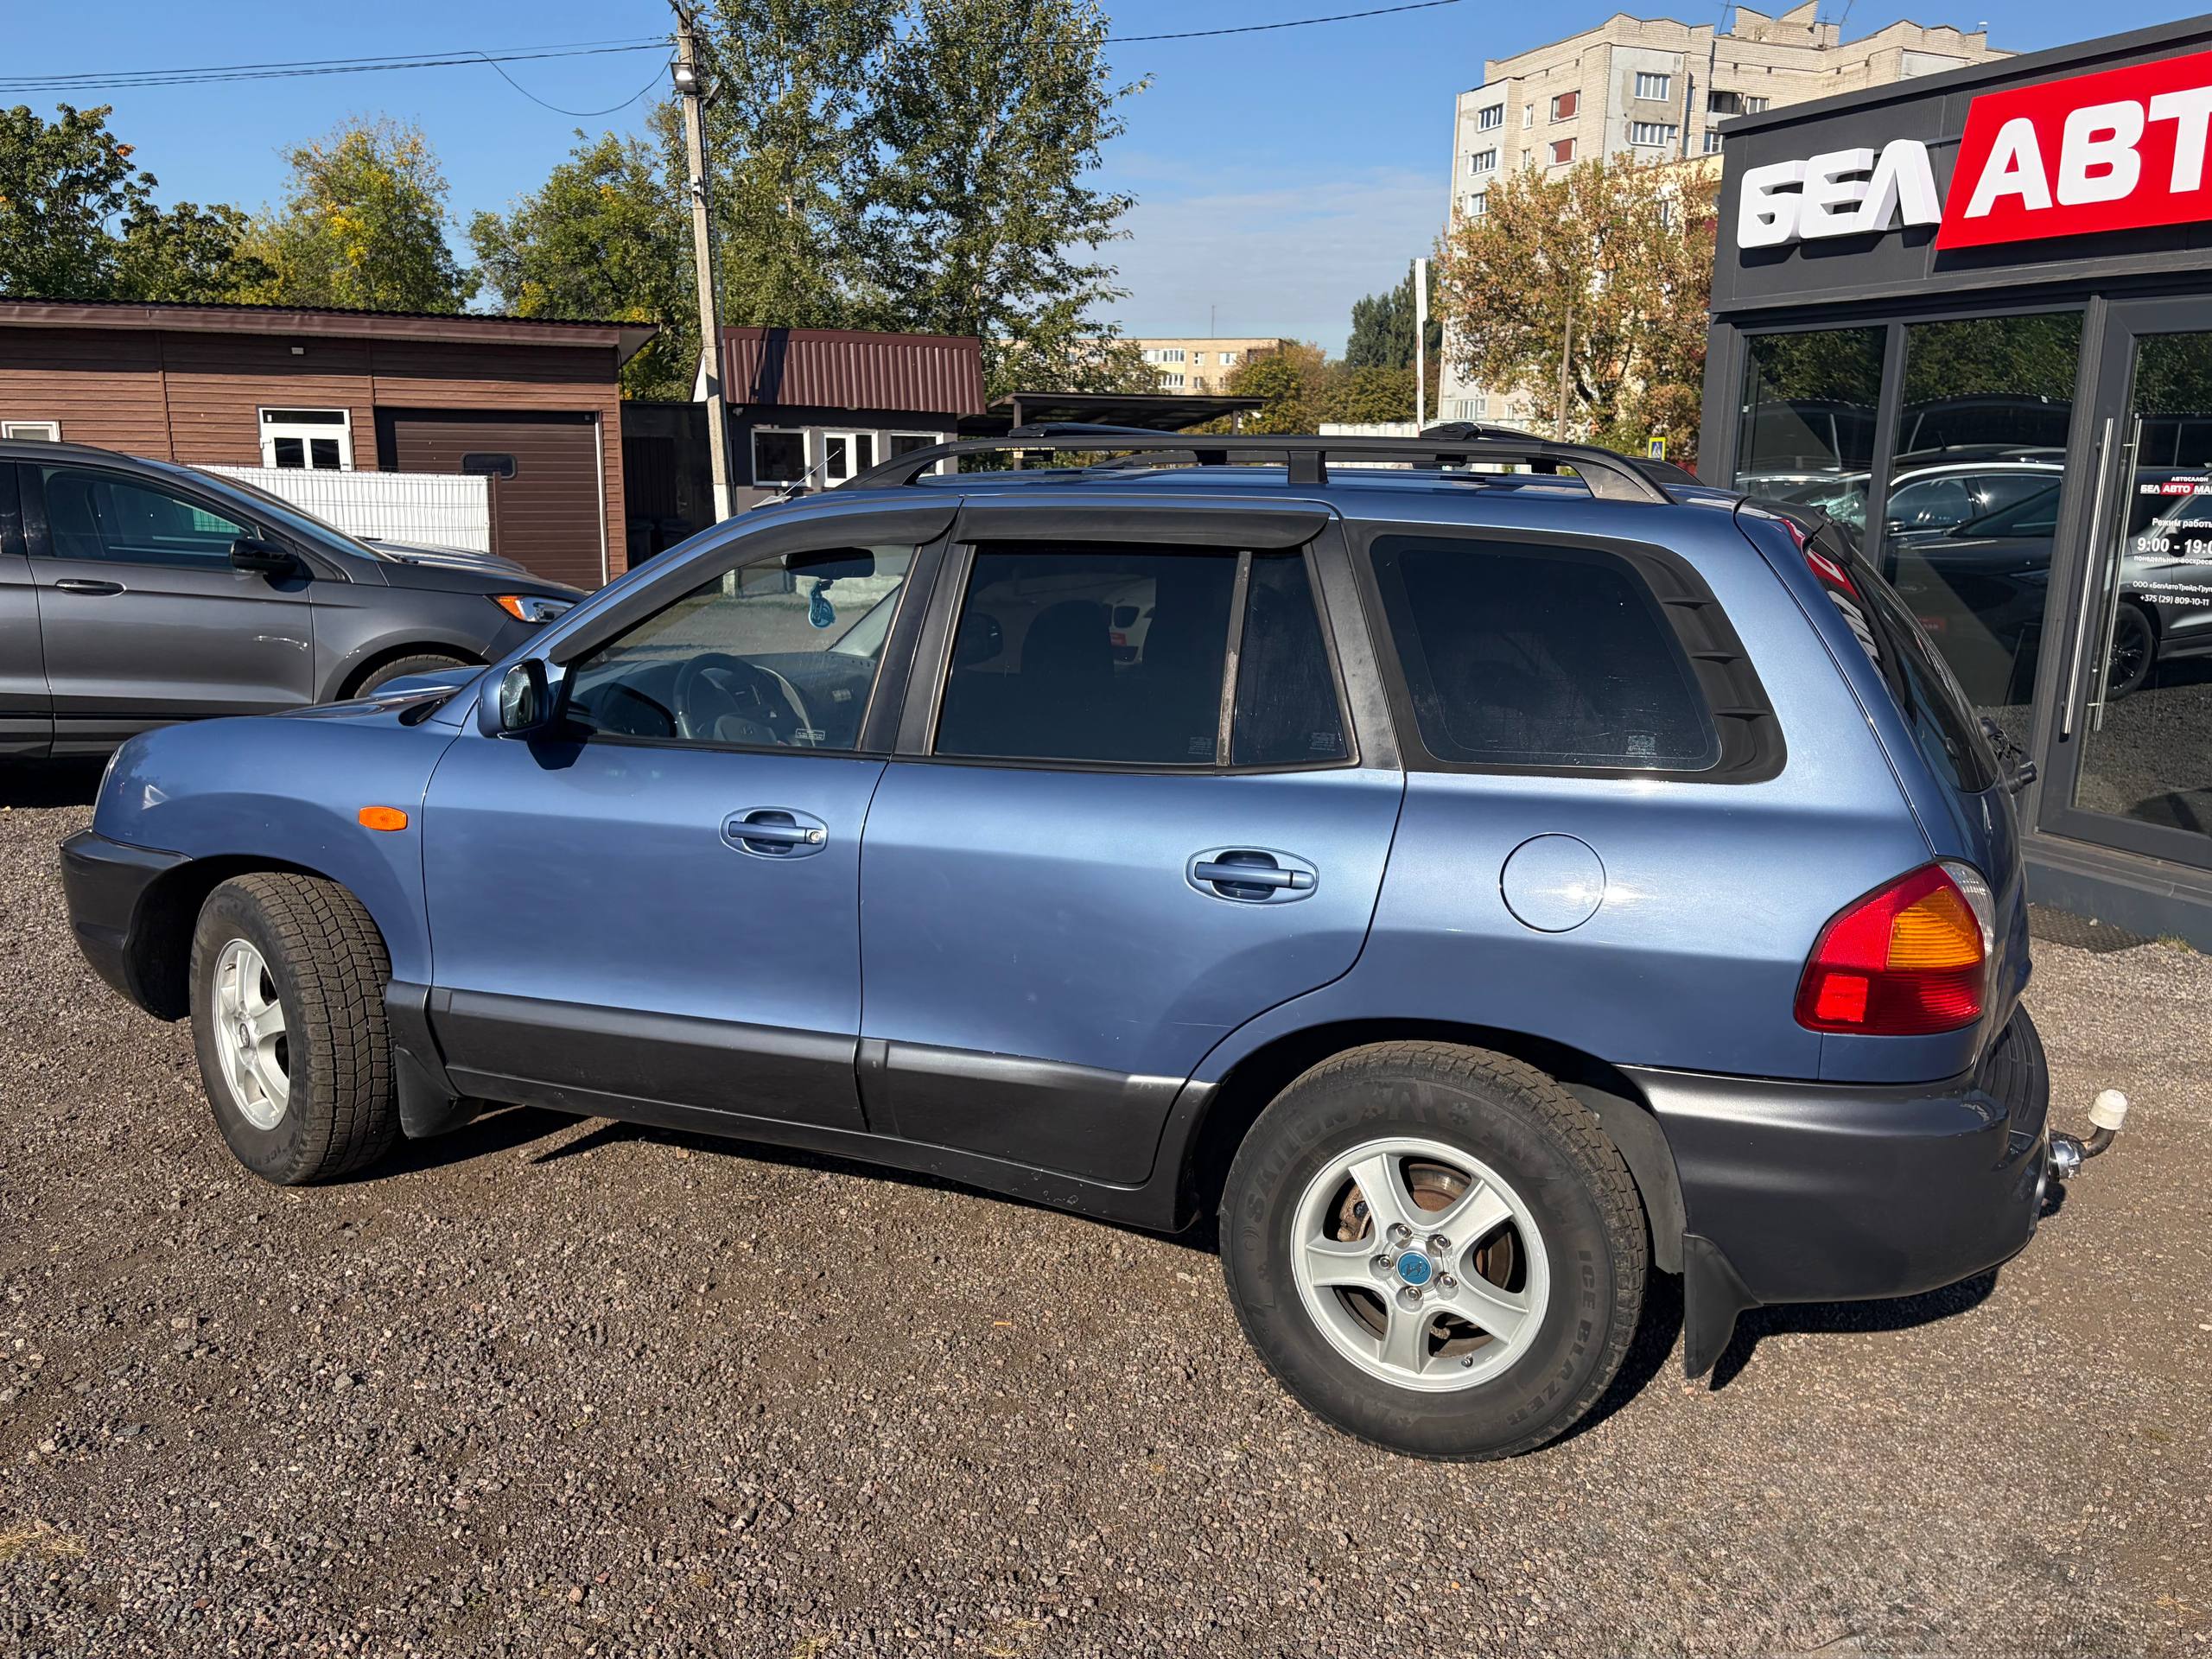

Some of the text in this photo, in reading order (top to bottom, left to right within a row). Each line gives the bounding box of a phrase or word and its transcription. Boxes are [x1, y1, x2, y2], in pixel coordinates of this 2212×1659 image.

[1737, 85, 2212, 250] БЕЛ АВТ
[2140, 484, 2212, 494] БЕЛ АВТО МА
[2152, 518, 2181, 527] Режим
[2137, 537, 2170, 552] 9:00
[2139, 594, 2209, 607] +375 (29) 809-10-11
